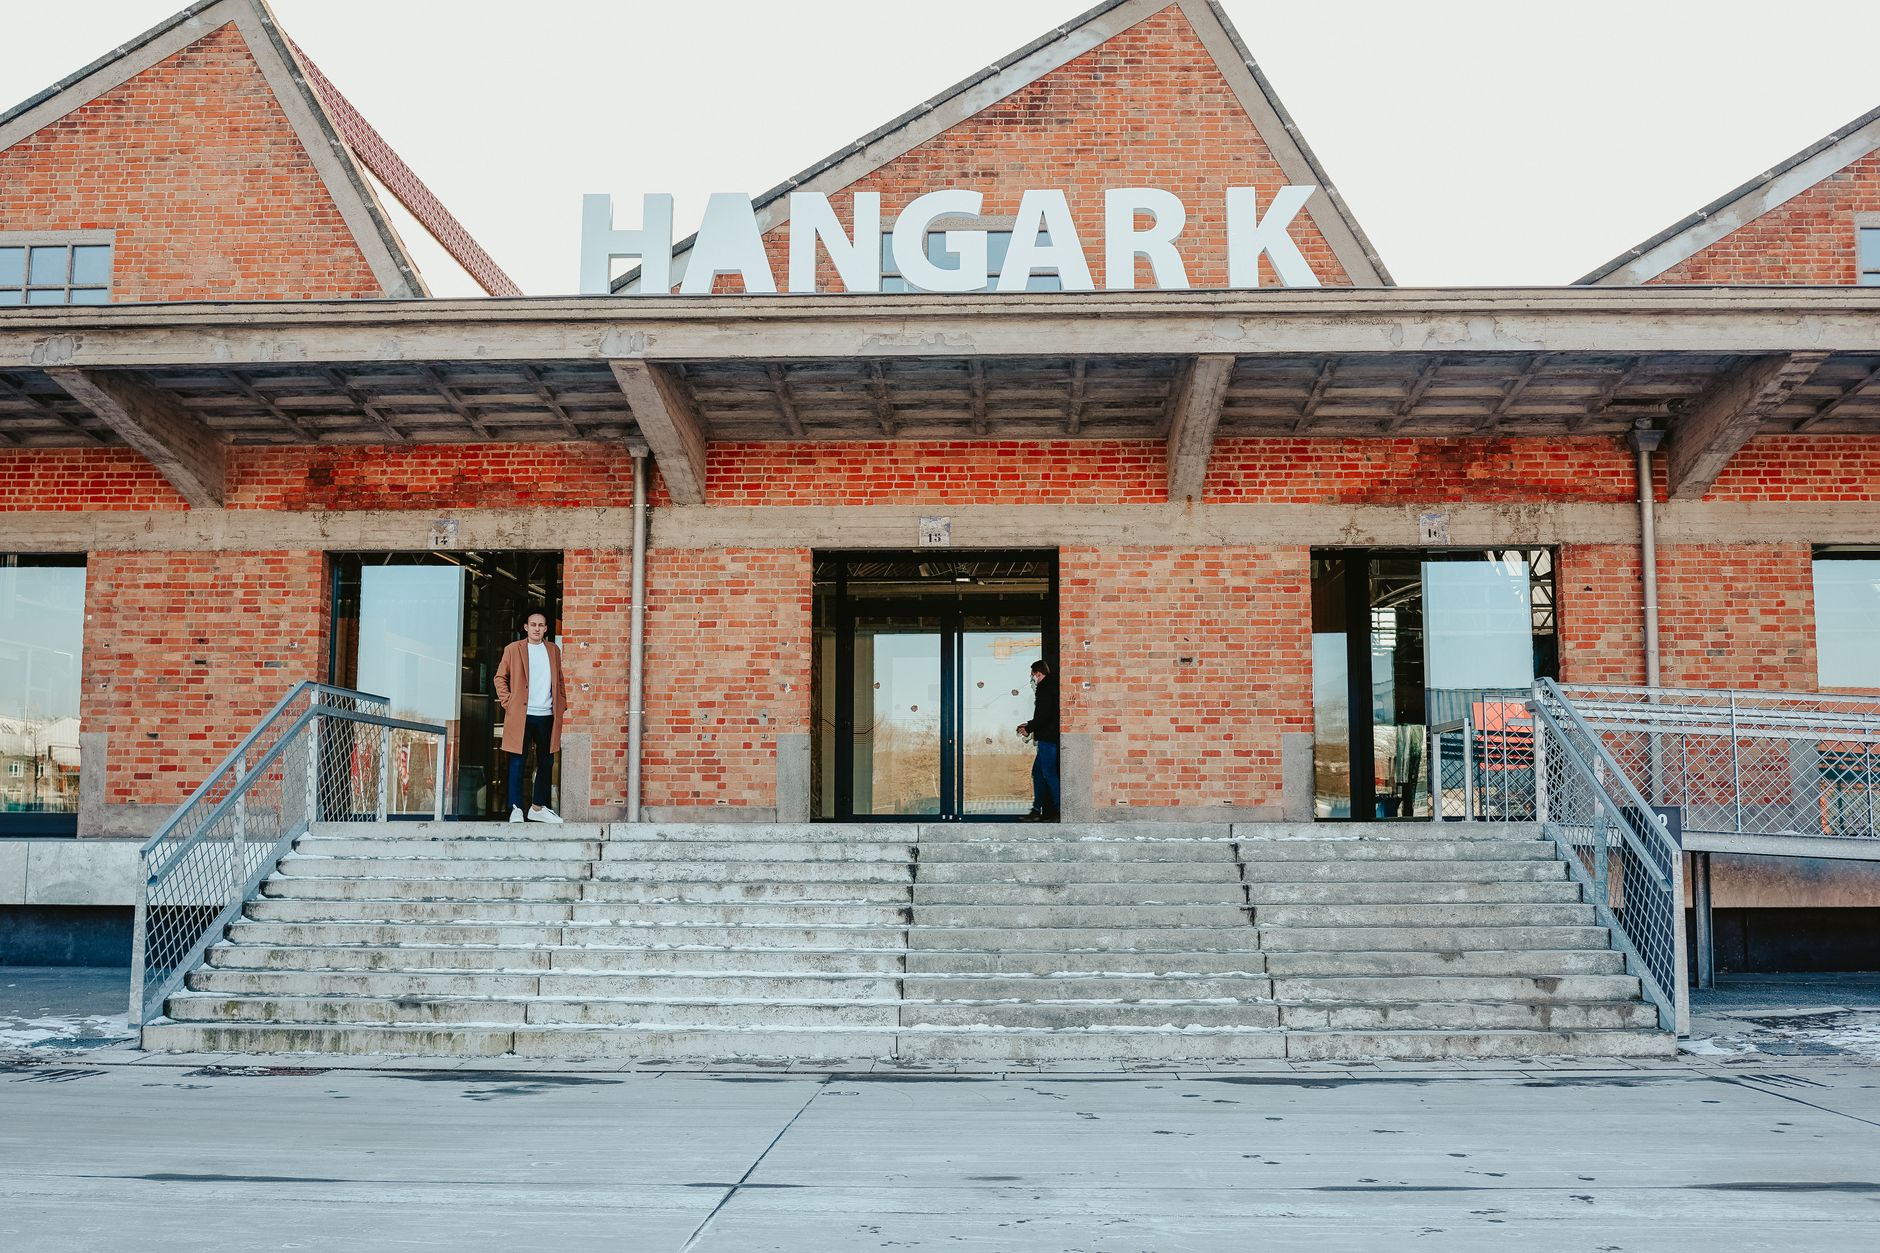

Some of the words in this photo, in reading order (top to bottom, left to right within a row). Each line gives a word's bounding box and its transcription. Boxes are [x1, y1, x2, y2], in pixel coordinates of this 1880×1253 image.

[579, 187, 1190, 294] HANGAR
[1226, 185, 1322, 288] K
[435, 535, 448, 545] 14
